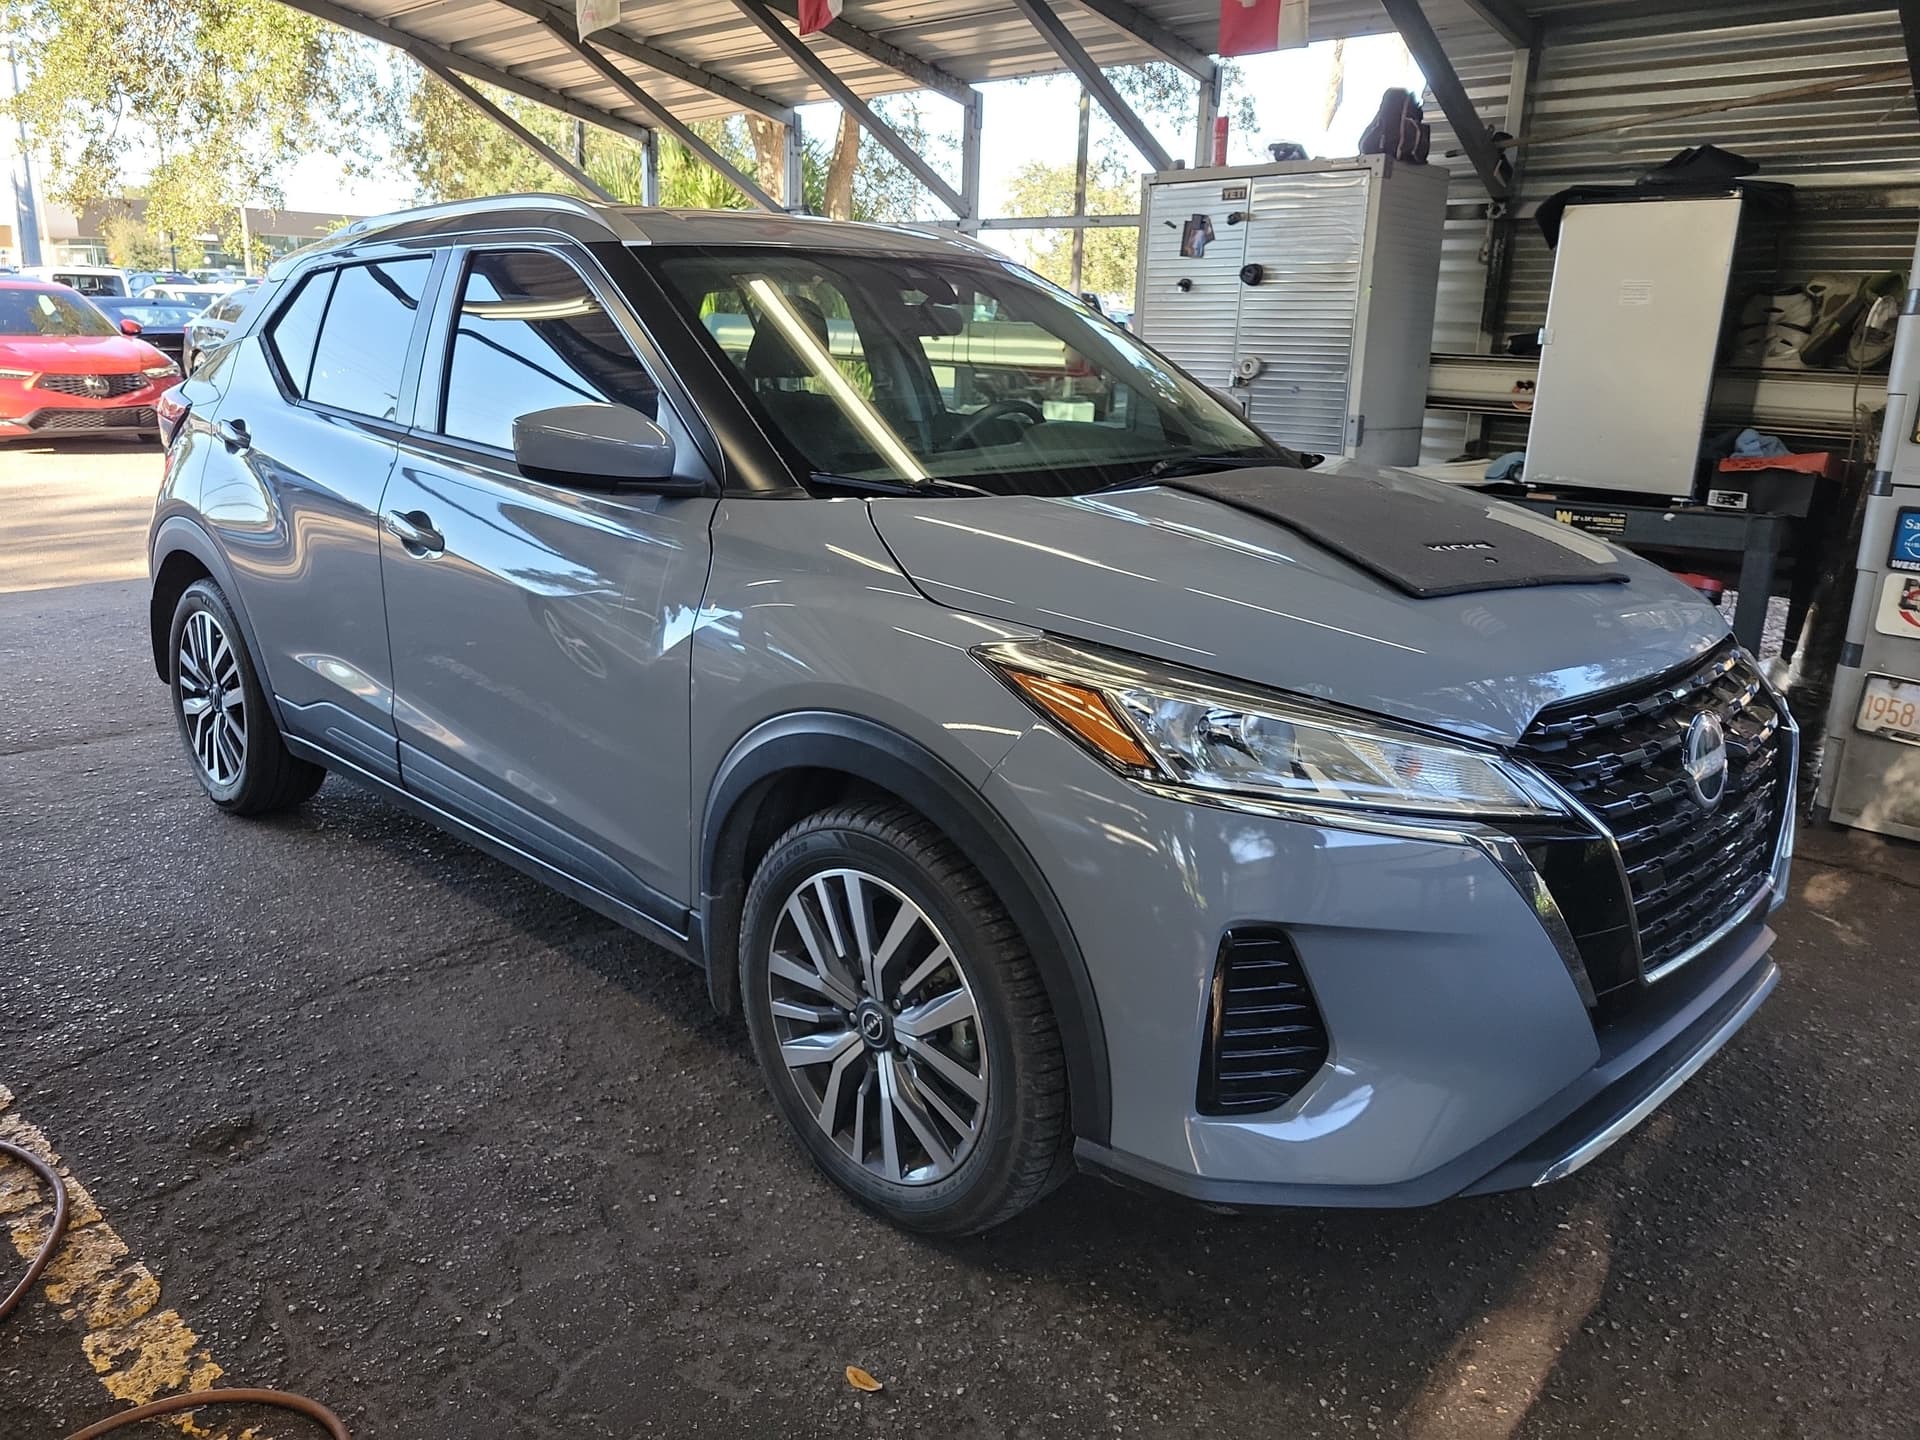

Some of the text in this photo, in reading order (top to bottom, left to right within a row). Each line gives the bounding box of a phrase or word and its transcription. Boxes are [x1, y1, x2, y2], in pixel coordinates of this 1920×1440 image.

[1225, 190, 1246, 199] YETI
[1555, 510, 1572, 525] W
[1865, 695, 1916, 728] 1958
